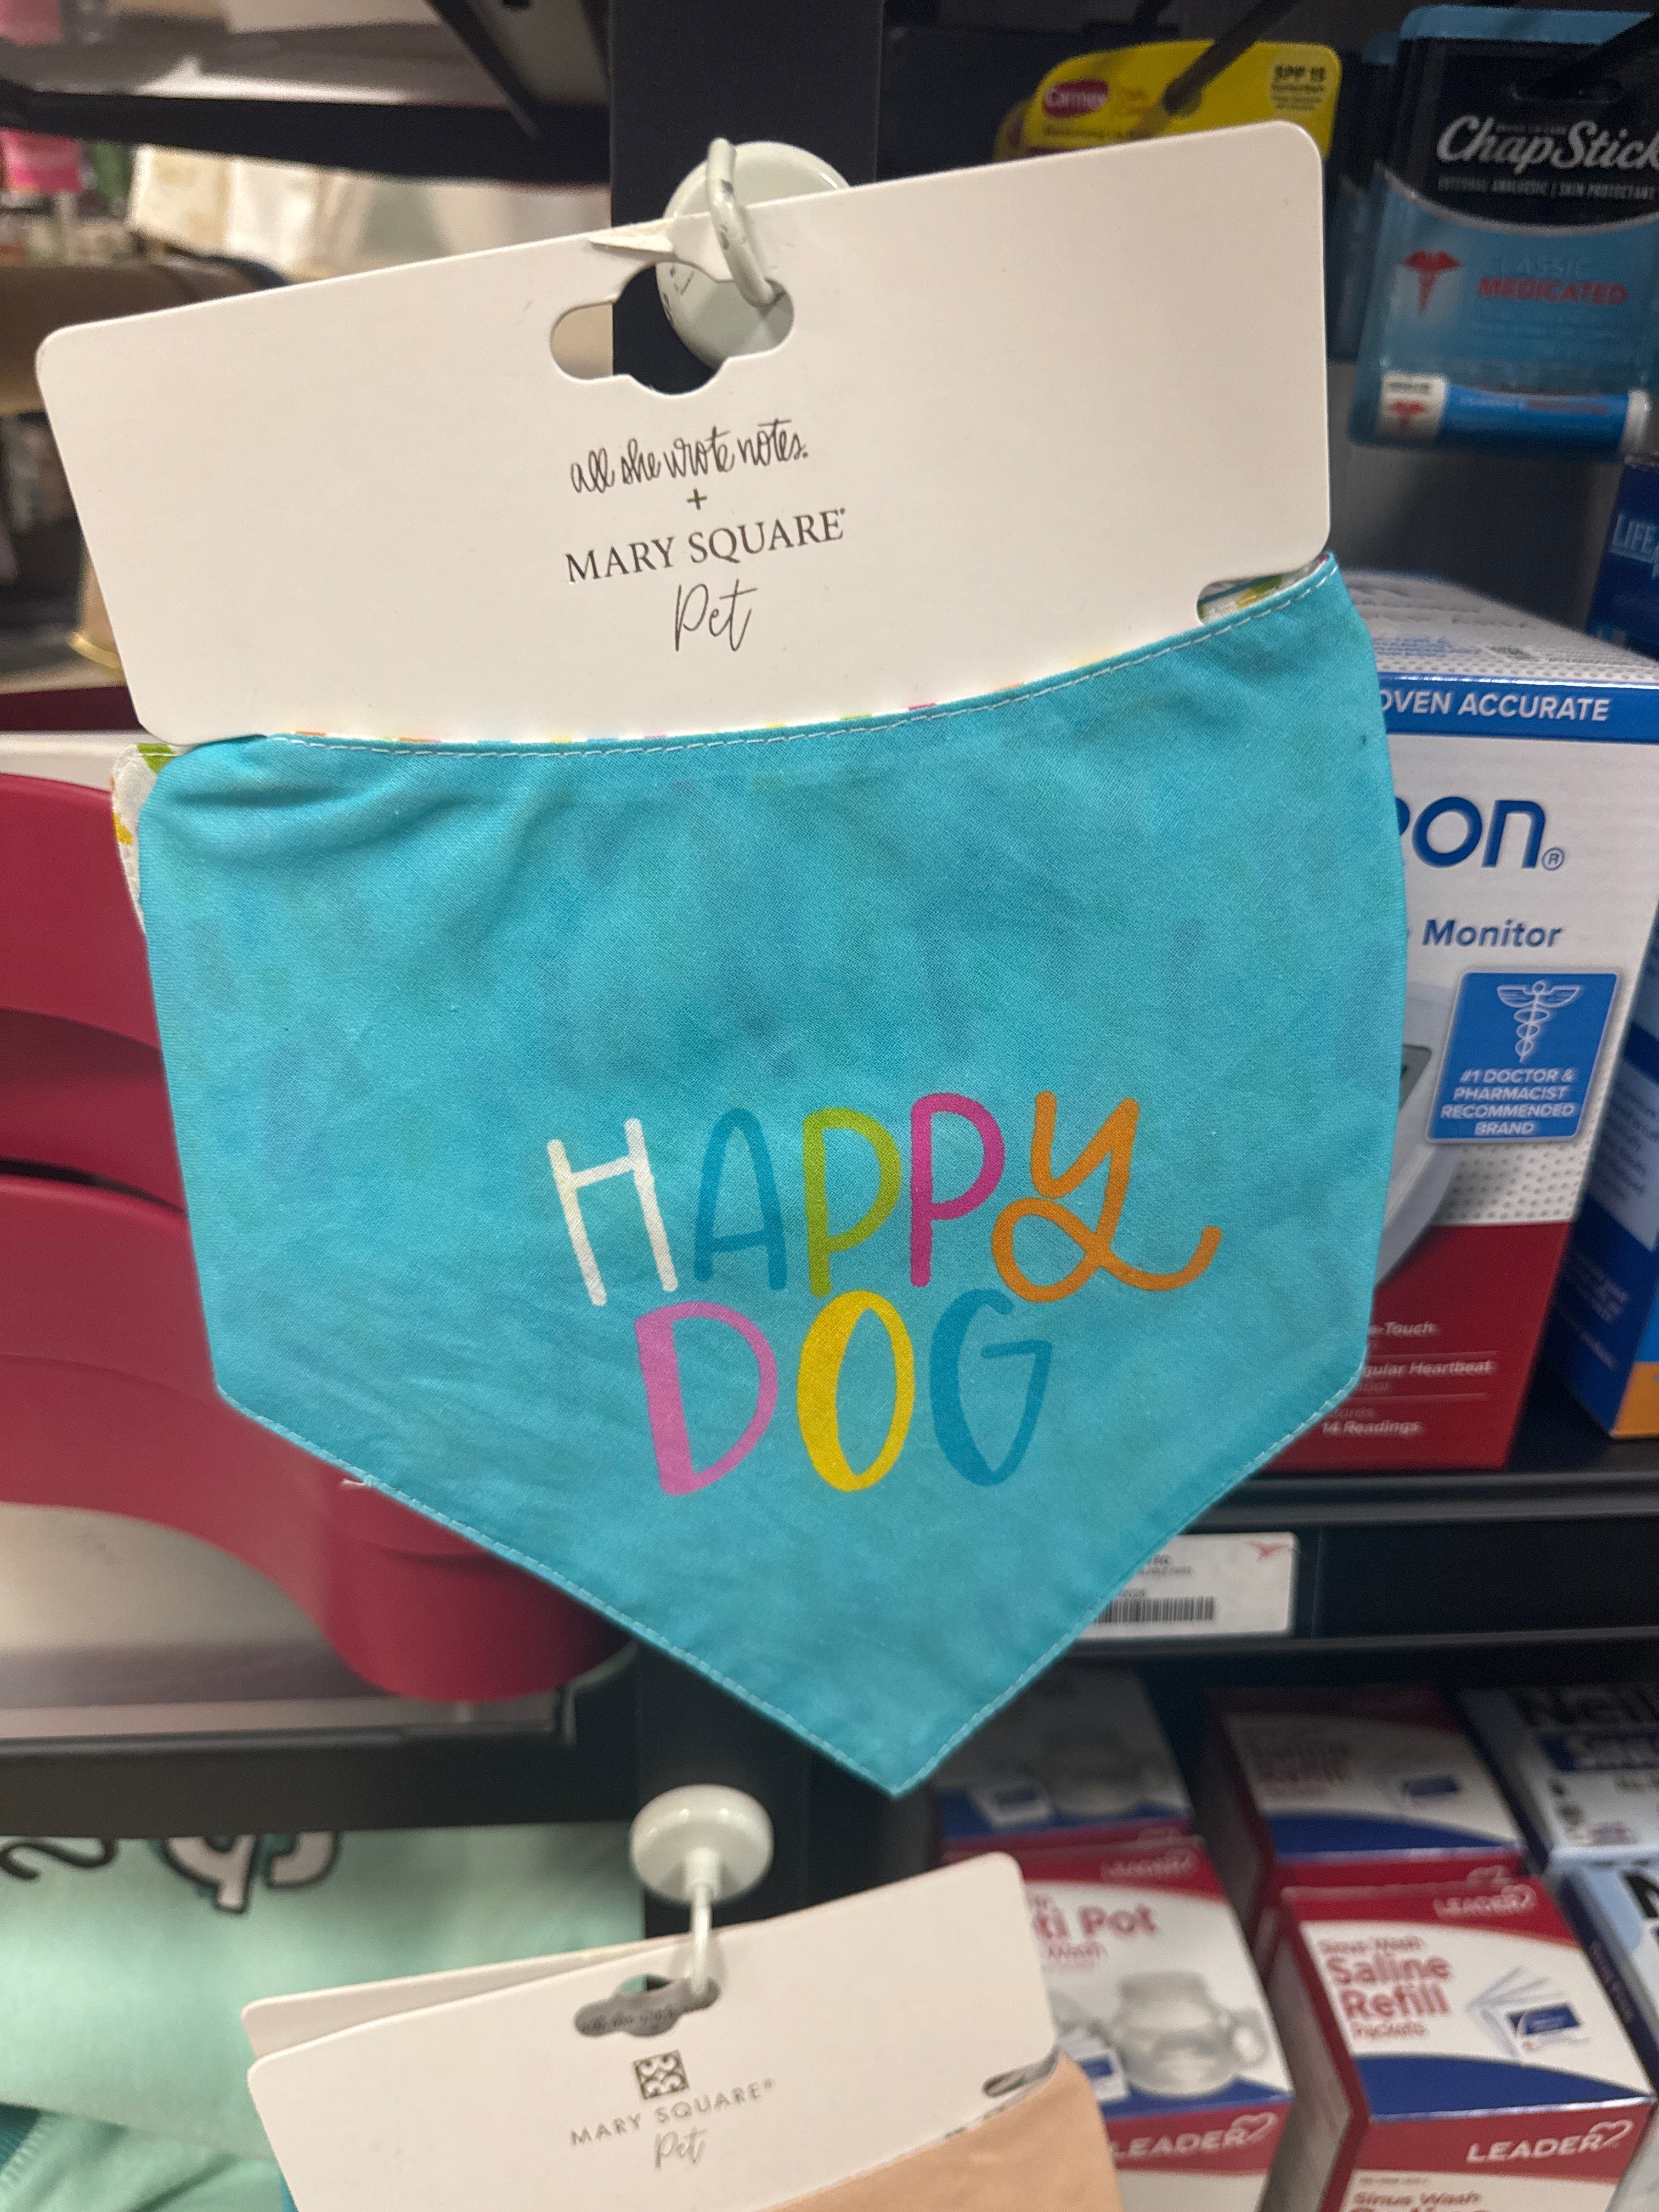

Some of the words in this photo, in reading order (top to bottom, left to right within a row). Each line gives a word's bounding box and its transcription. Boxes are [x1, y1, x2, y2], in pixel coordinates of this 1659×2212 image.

[1478, 277, 1629, 306] MEDICATED
[571, 448, 615, 493] all
[620, 438, 661, 484] she
[662, 426, 735, 478] wrote
[566, 536, 675, 584] MARY
[674, 578, 759, 652] Pet
[1378, 690, 1451, 715] OVEN
[1457, 692, 1611, 723] ACCURATE
[1421, 918, 1564, 948] Monitor
[1459, 1068, 1481, 1084] #1
[1482, 1068, 1559, 1084] DOCTOR
[1561, 1068, 1577, 1083] &
[1452, 1085, 1570, 1101] PHARMACIST
[1440, 1103, 1577, 1119] RECOMMENDED
[1474, 1121, 1536, 1136] BRAND
[546, 1091, 1223, 1307] HAPPY
[1368, 1321, 1438, 1336] e-Touch
[1364, 1359, 1406, 1378] gular
[1408, 1359, 1496, 1376] Heartbeat
[634, 1288, 1053, 1496] DOG
[1342, 1420, 1423, 1436] Readings
[1078, 1902, 1158, 1937] Pot
[1326, 1954, 1452, 1985] Saline
[1339, 1986, 1452, 2019] Refill
[571, 2113, 642, 2147] MARY
[1111, 2126, 1248, 2159] LEADER
[654, 2126, 708, 2169] Pet
[1465, 2132, 1604, 2163] LEADER
[1353, 2191, 1413, 2206] Sinus
[1419, 2189, 1482, 2205] Wash
